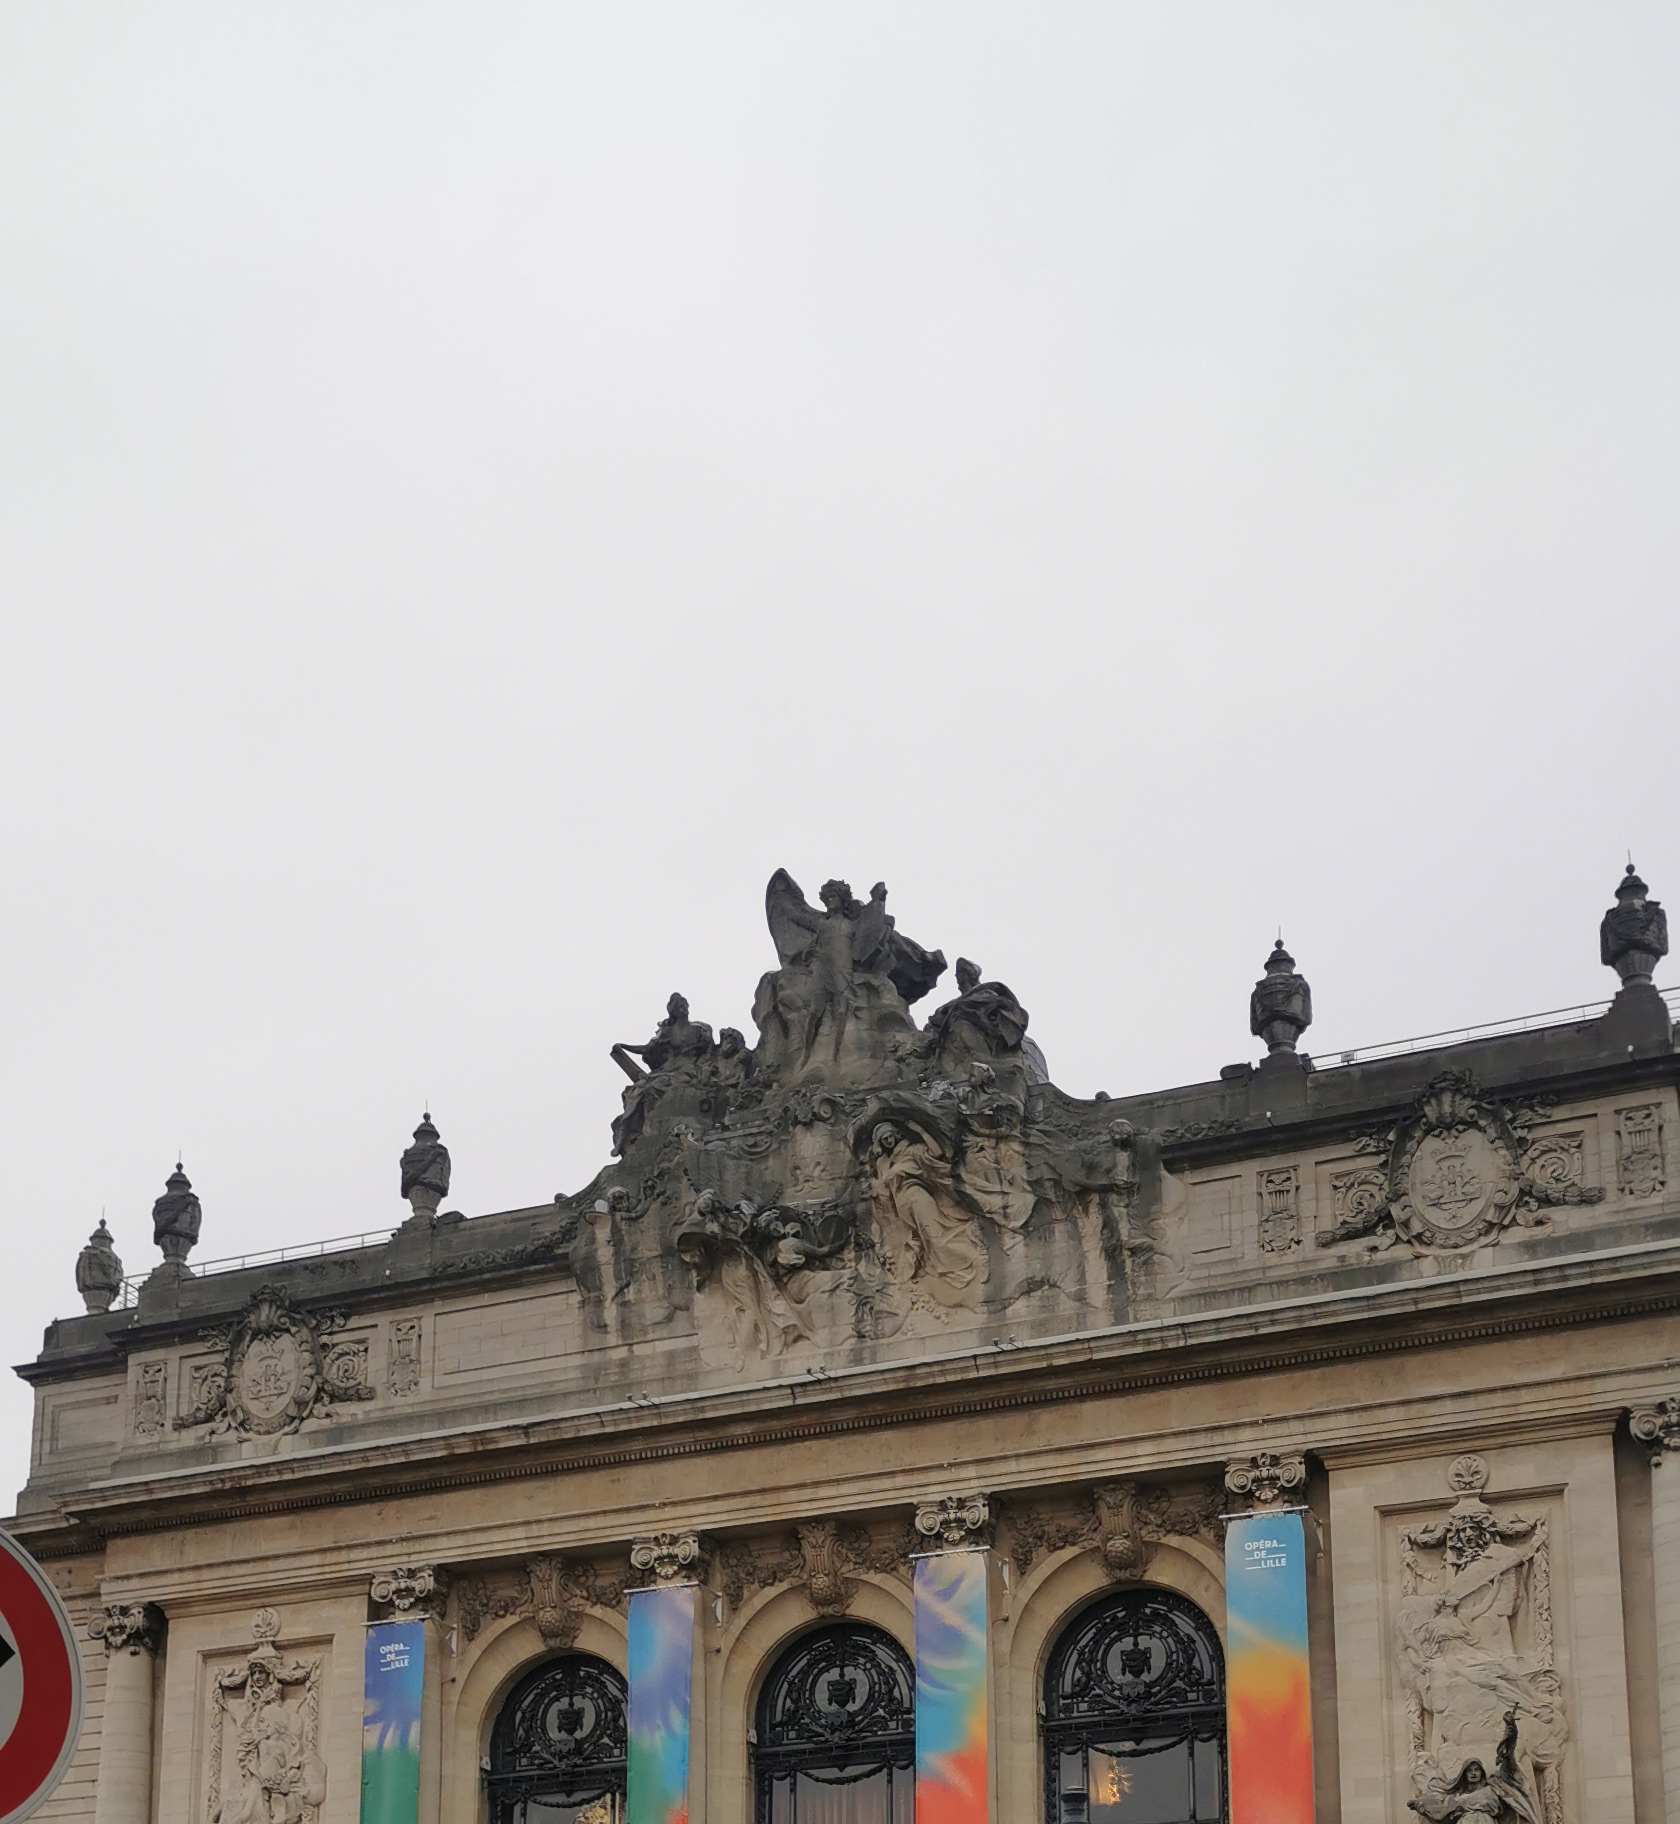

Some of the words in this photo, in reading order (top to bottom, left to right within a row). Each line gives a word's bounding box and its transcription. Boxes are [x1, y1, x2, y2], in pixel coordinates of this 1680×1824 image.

[1244, 1539, 1278, 1551] OPÉRA
[1253, 1550, 1267, 1559] DE
[1261, 1557, 1287, 1568] LILLE
